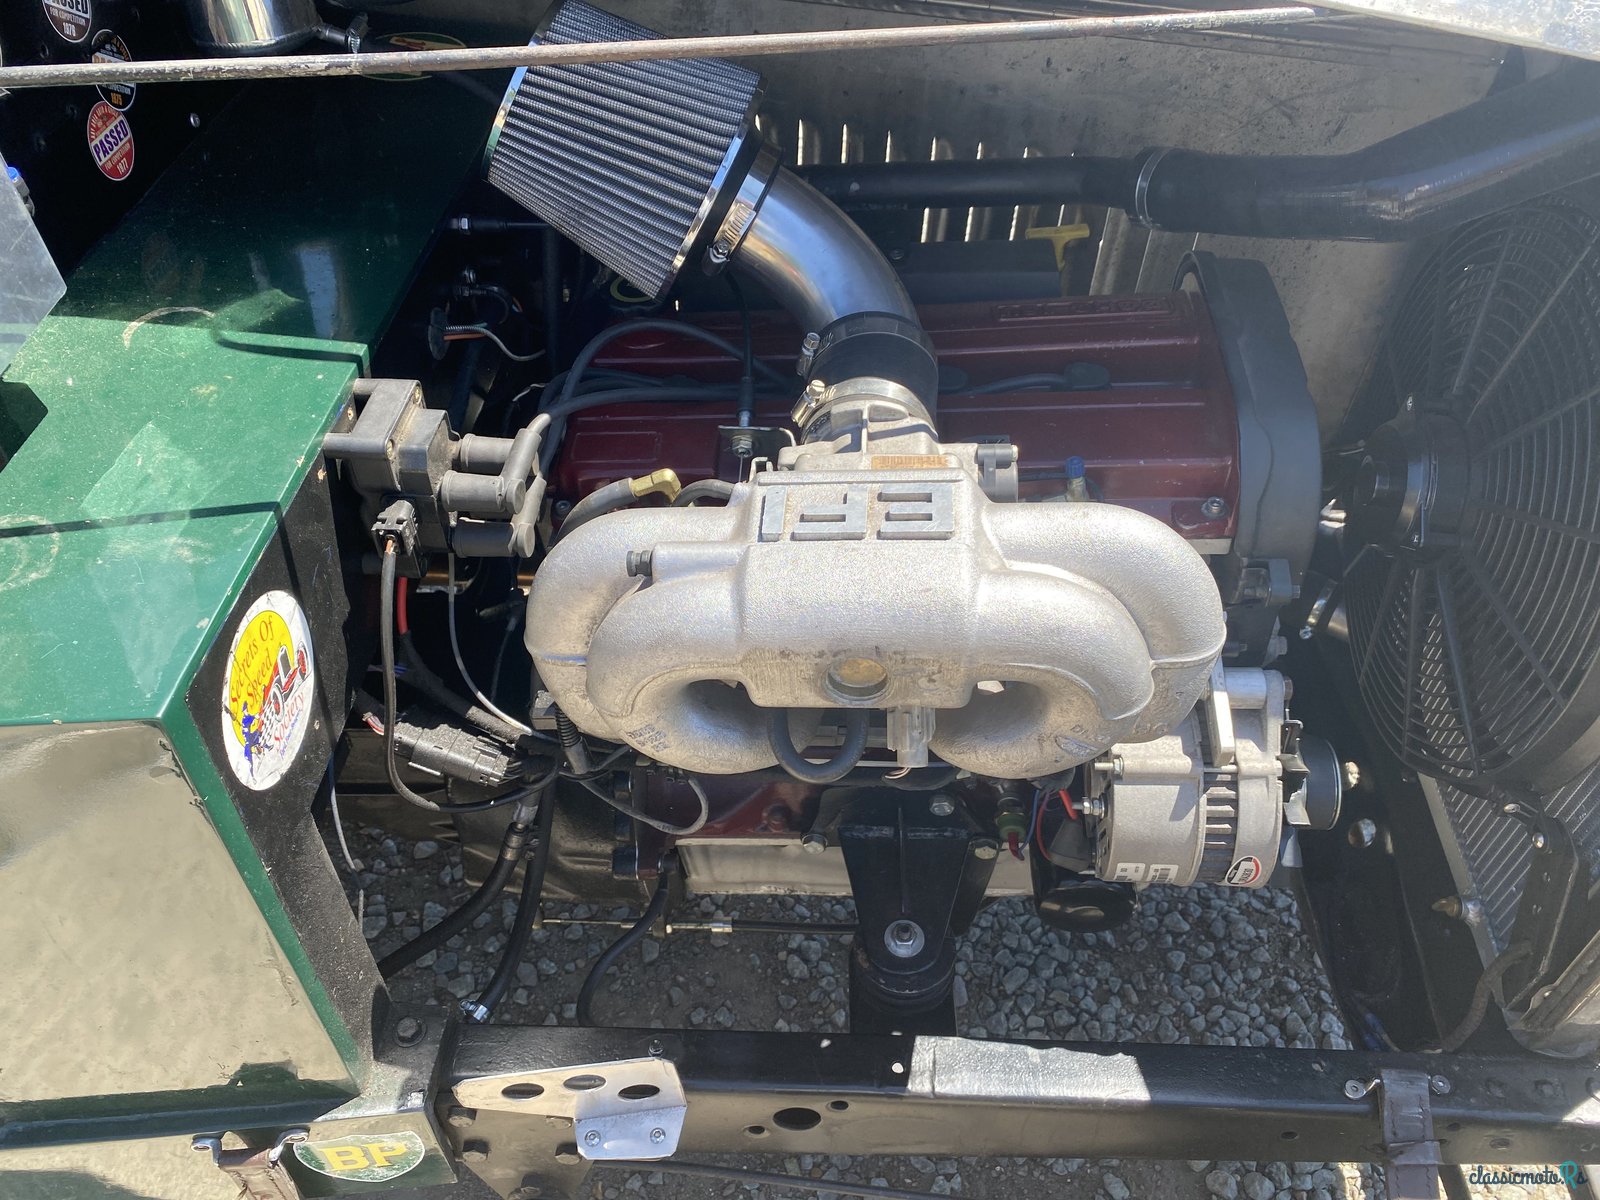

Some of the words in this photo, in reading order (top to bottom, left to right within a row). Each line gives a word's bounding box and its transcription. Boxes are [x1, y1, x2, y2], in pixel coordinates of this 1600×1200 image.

[93, 119, 129, 162] PASSED
[117, 157, 129, 175] 1977
[758, 484, 955, 541] EFI
[230, 638, 259, 714] Secrets
[260, 615, 274, 641] Of
[246, 647, 273, 709] Speed
[274, 691, 304, 752] Society
[319, 1142, 407, 1172] BP
